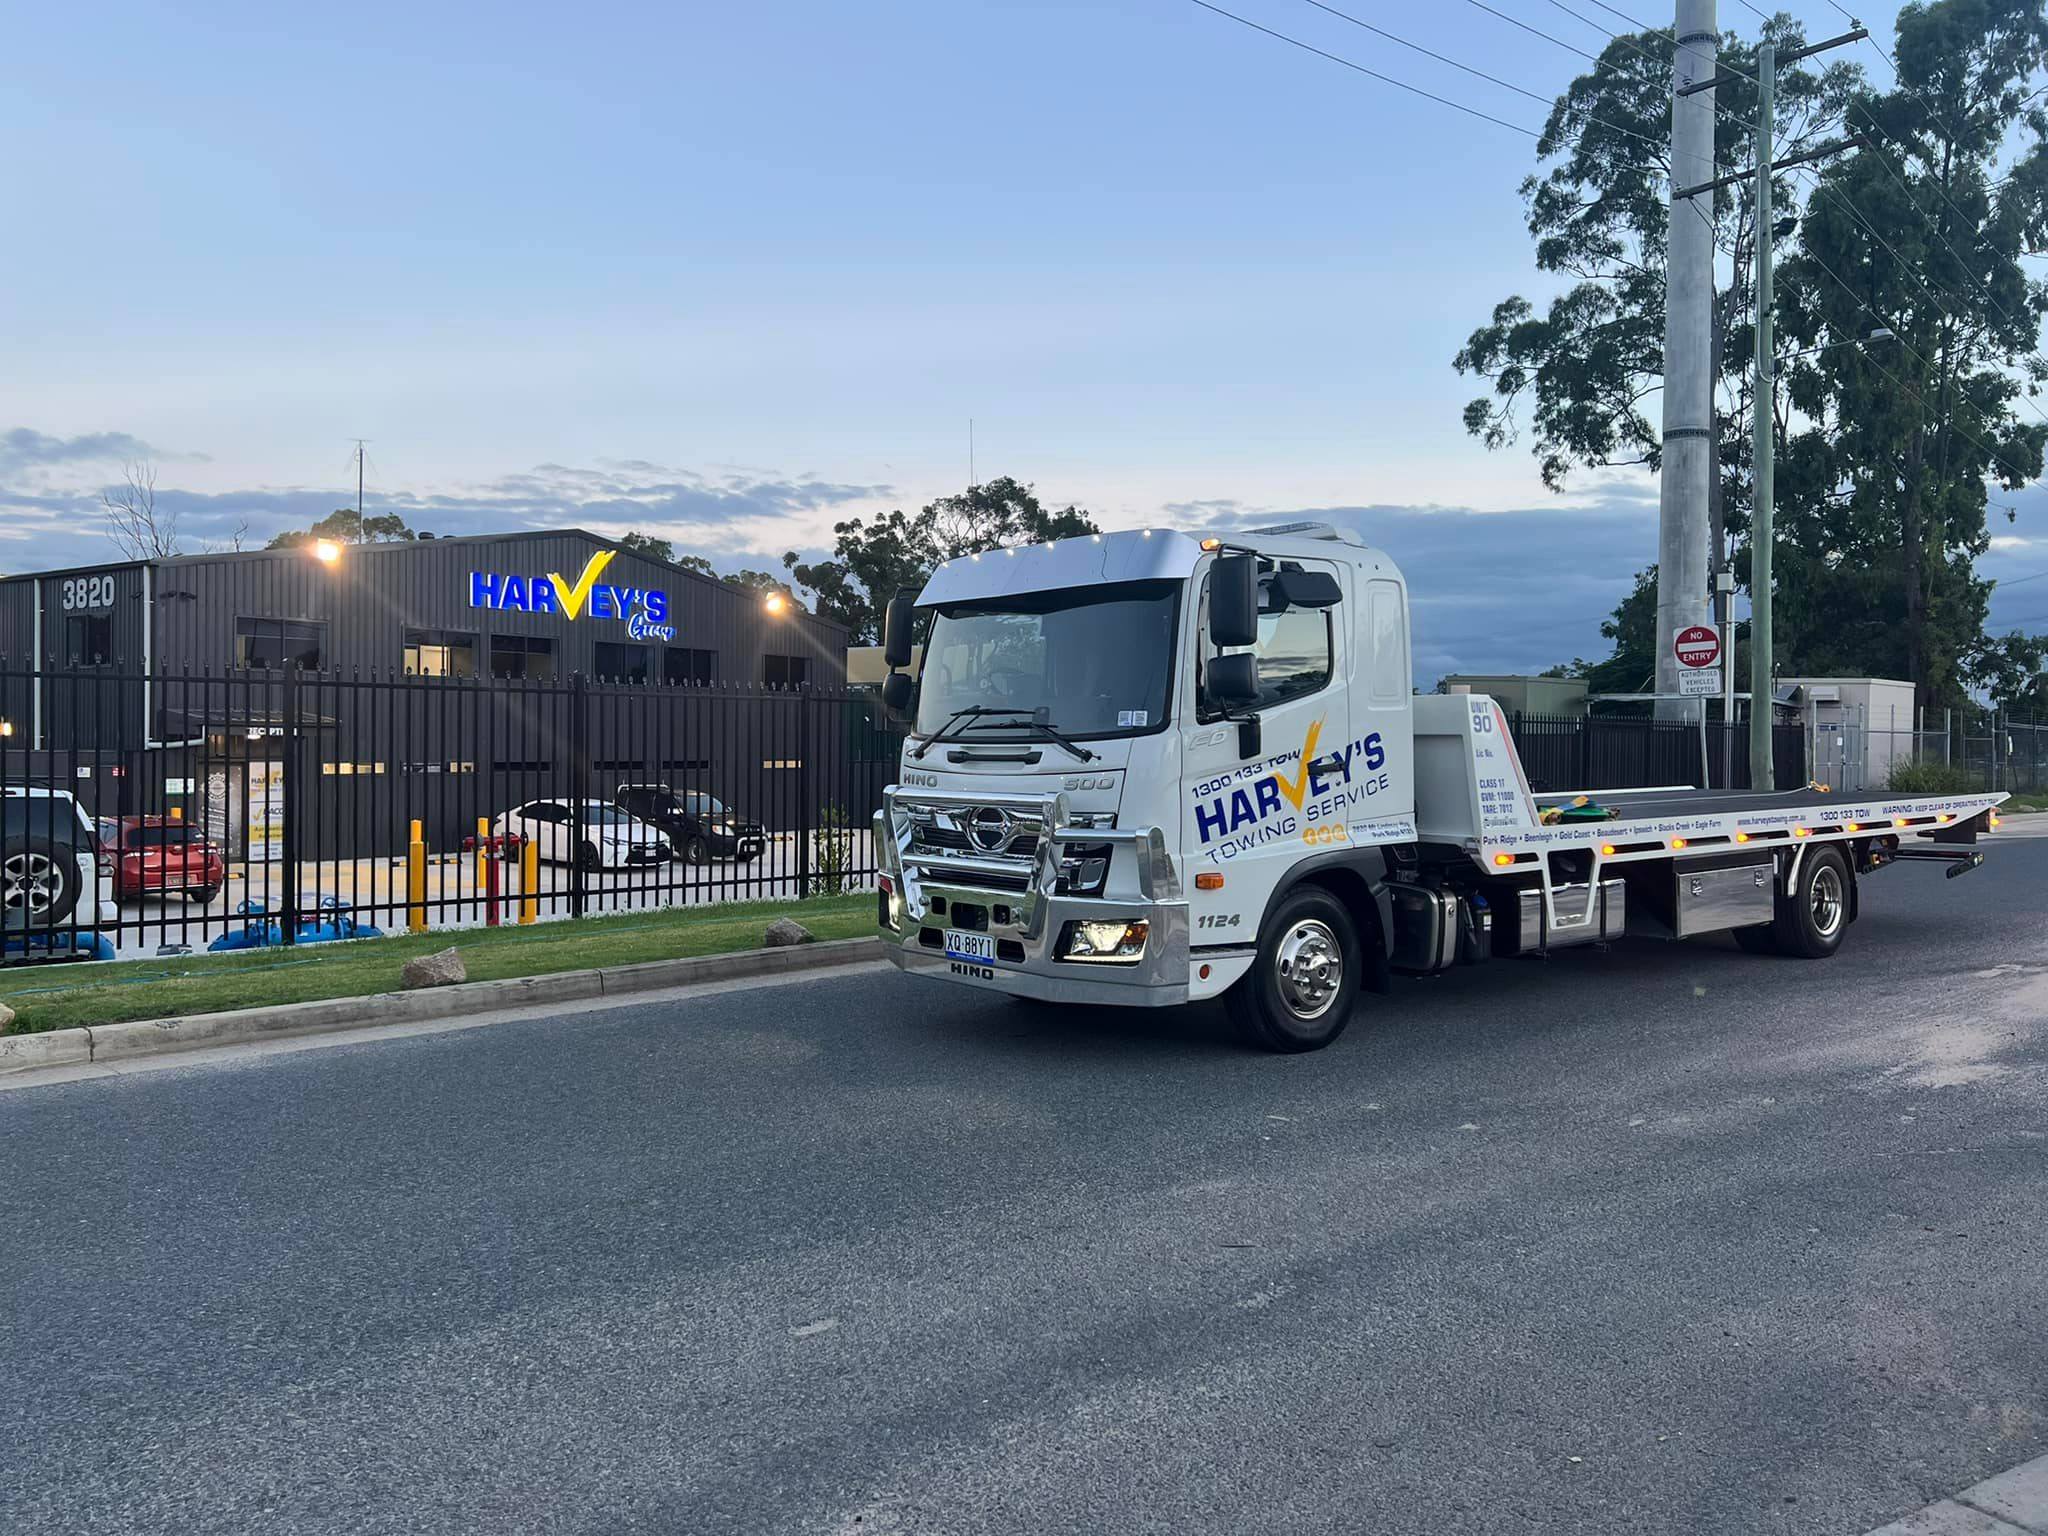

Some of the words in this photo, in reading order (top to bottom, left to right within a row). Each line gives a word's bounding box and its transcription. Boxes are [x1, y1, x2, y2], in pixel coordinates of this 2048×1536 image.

[63, 576, 114, 610] 3820
[470, 550, 668, 622] HARVEY'S
[626, 612, 677, 642] Group
[1690, 631, 1702, 640] NO
[1683, 652, 1712, 662] ENTRY
[1470, 702, 1488, 713] UNIT
[1473, 715, 1492, 733] 90
[903, 773, 938, 788] HINO
[1192, 775, 1232, 798] 1300
[1234, 763, 1264, 780] 133
[1267, 748, 1301, 768] TOW
[1063, 776, 1116, 791] 500
[1480, 778, 1497, 789] CLASS
[1481, 791, 1497, 802] GVM:
[1819, 811, 1838, 821] 1300
[1839, 810, 1853, 820] 133
[1854, 808, 1871, 818] TOW
[1882, 804, 1914, 815] WARNING:
[1929, 803, 1945, 811] CLEAR
[1205, 816, 1297, 864] TOWING
[1307, 773, 1390, 822] SERVICE
[1483, 836, 1498, 845] Park
[1500, 834, 1517, 846] Ridge
[1524, 832, 1553, 843] Beenleigh
[1559, 831, 1573, 840] Gold
[1574, 830, 1591, 839] Coast
[1676, 822, 1690, 831] Creek
[1695, 820, 1709, 831] Eagle
[1710, 819, 1722, 828] Farm
[1198, 914, 1240, 928] 1124
[951, 963, 993, 980] HINO
